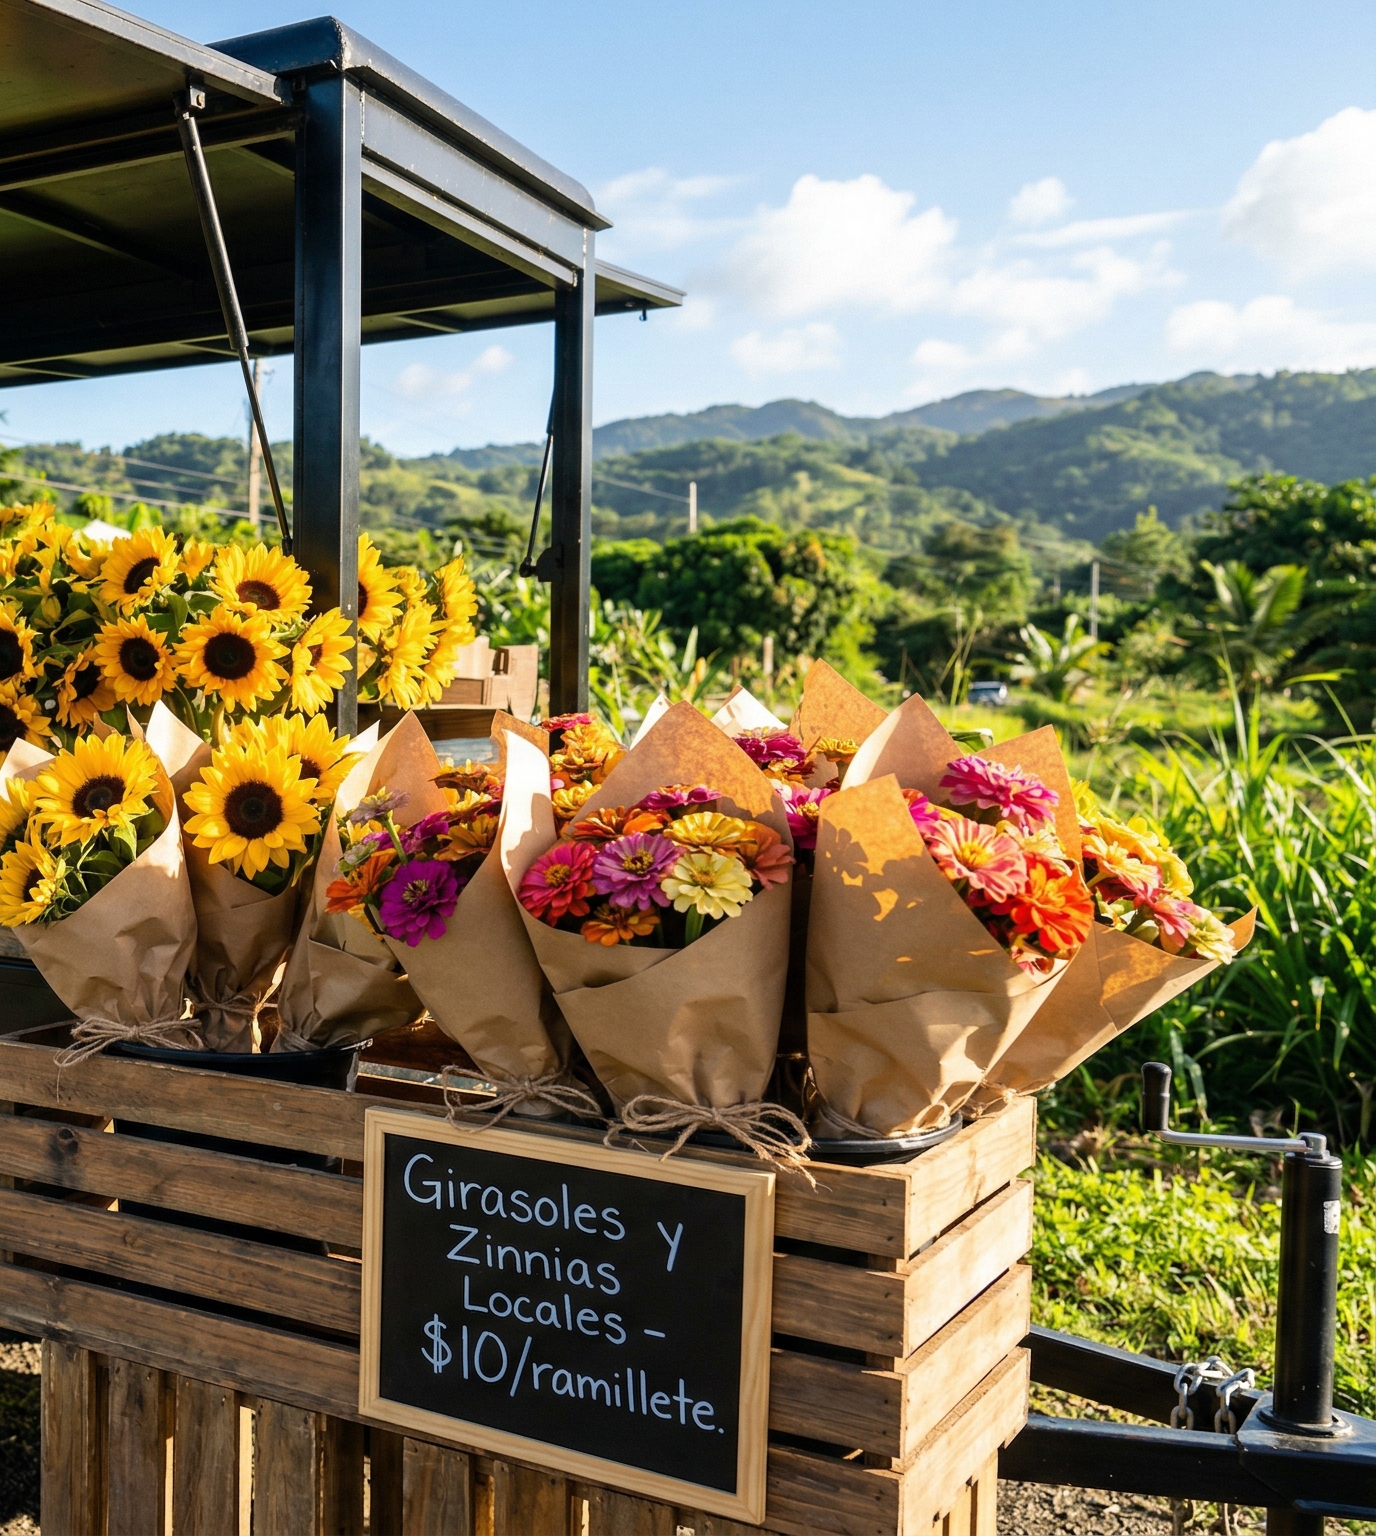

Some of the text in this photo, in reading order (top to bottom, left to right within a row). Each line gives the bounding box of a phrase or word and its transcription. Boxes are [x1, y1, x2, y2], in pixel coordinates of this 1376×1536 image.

[403, 1153, 626, 1241] Girasoles
[446, 1223, 621, 1295] Zinnias
[463, 1275, 627, 1345] Locales
[421, 1313, 725, 1434] $10/ramillete.
